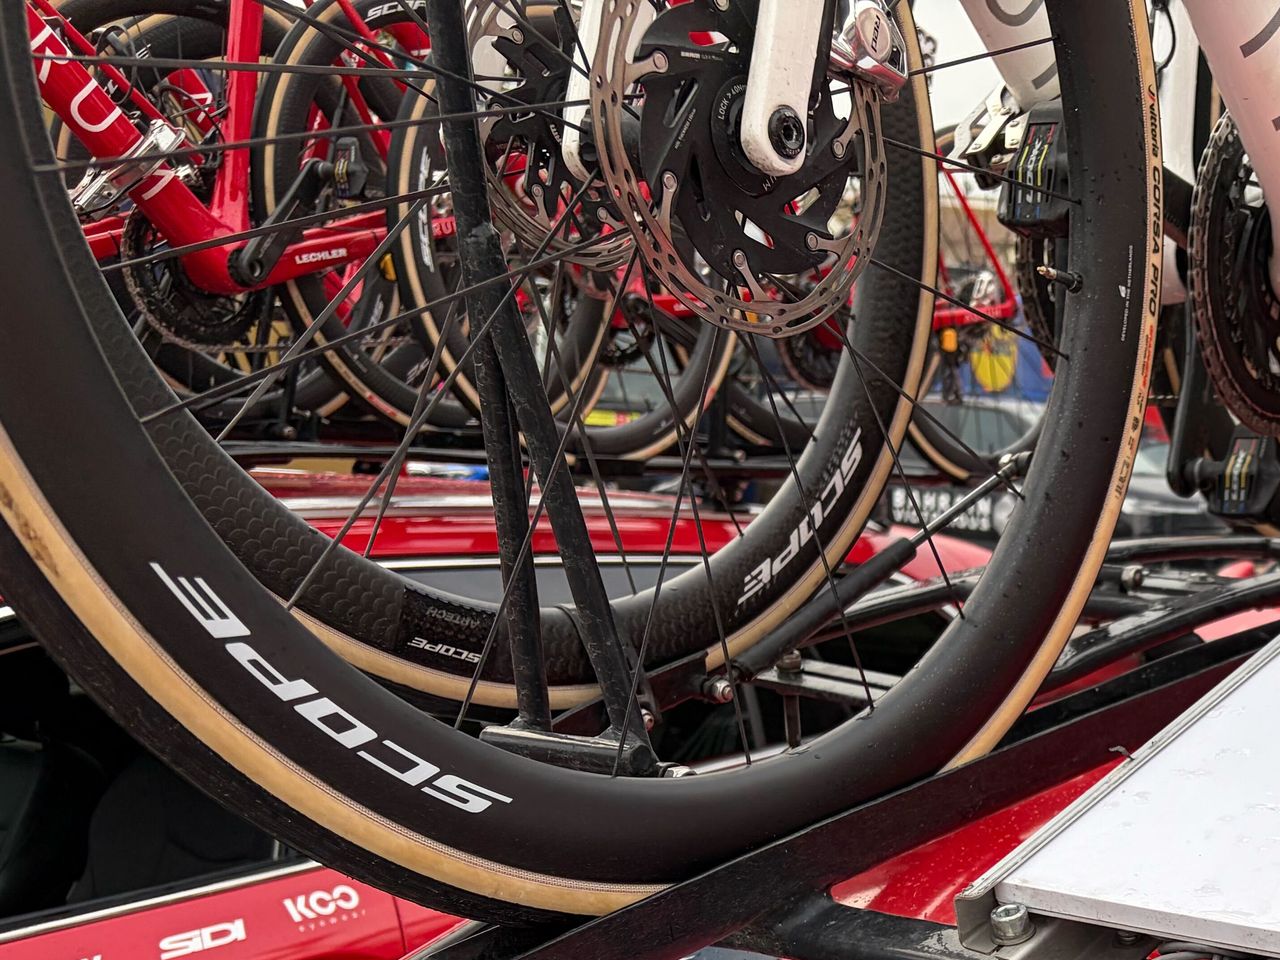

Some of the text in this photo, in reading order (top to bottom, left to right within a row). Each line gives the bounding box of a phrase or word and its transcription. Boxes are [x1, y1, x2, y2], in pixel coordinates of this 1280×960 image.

[717, 98, 730, 121] LOCK
[1151, 164, 1164, 255] CORSA
[295, 247, 348, 265] LECHLER
[1148, 262, 1160, 318] PRO
[737, 426, 863, 606] SCOPE
[426, 606, 480, 630] ARTECH
[407, 636, 482, 664] SCOPE
[150, 562, 513, 814] SCOPE
[283, 884, 360, 923] KOO
[158, 918, 248, 960] SIDI
